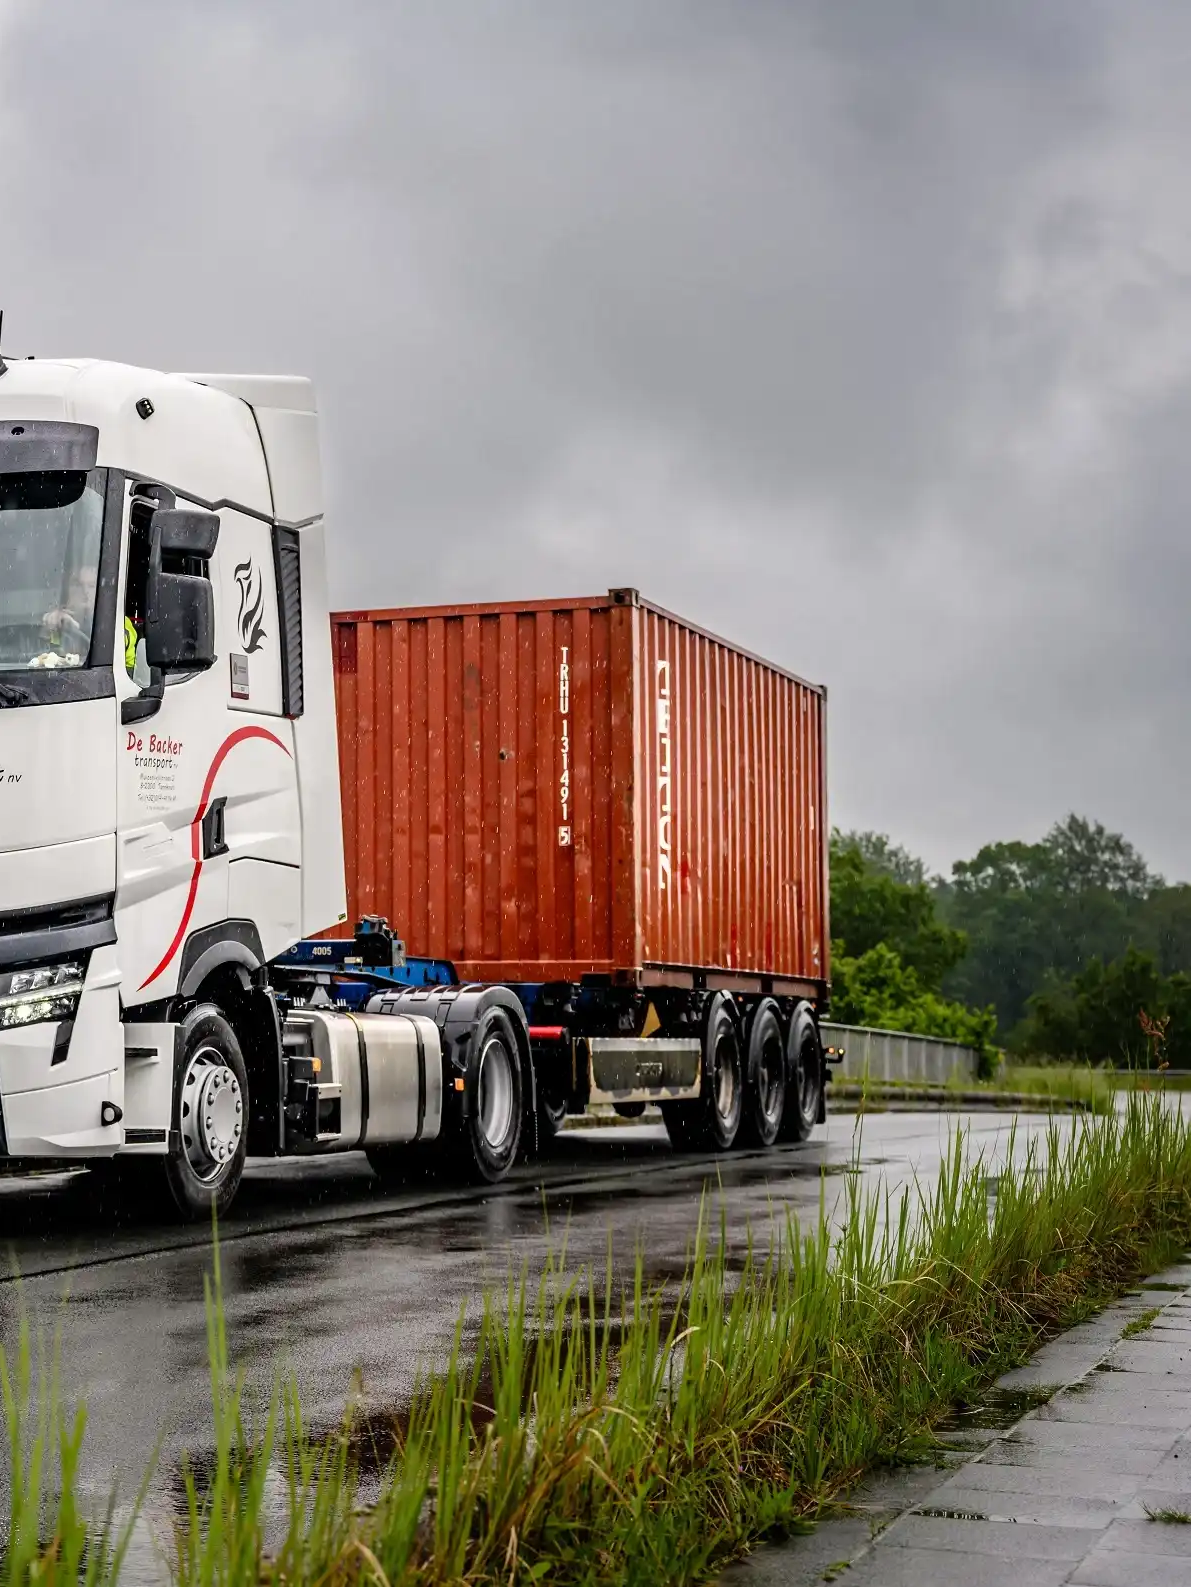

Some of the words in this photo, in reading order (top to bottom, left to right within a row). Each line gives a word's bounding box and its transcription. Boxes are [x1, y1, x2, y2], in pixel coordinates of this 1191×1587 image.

[559, 647, 569, 714] TRHU
[127, 732, 142, 751] De
[149, 734, 183, 755] Backer
[135, 754, 172, 772] transport
[559, 720, 569, 820] 131491
[7, 773, 23, 783] nv
[560, 828, 570, 845] 5
[312, 947, 331, 955] 4005
